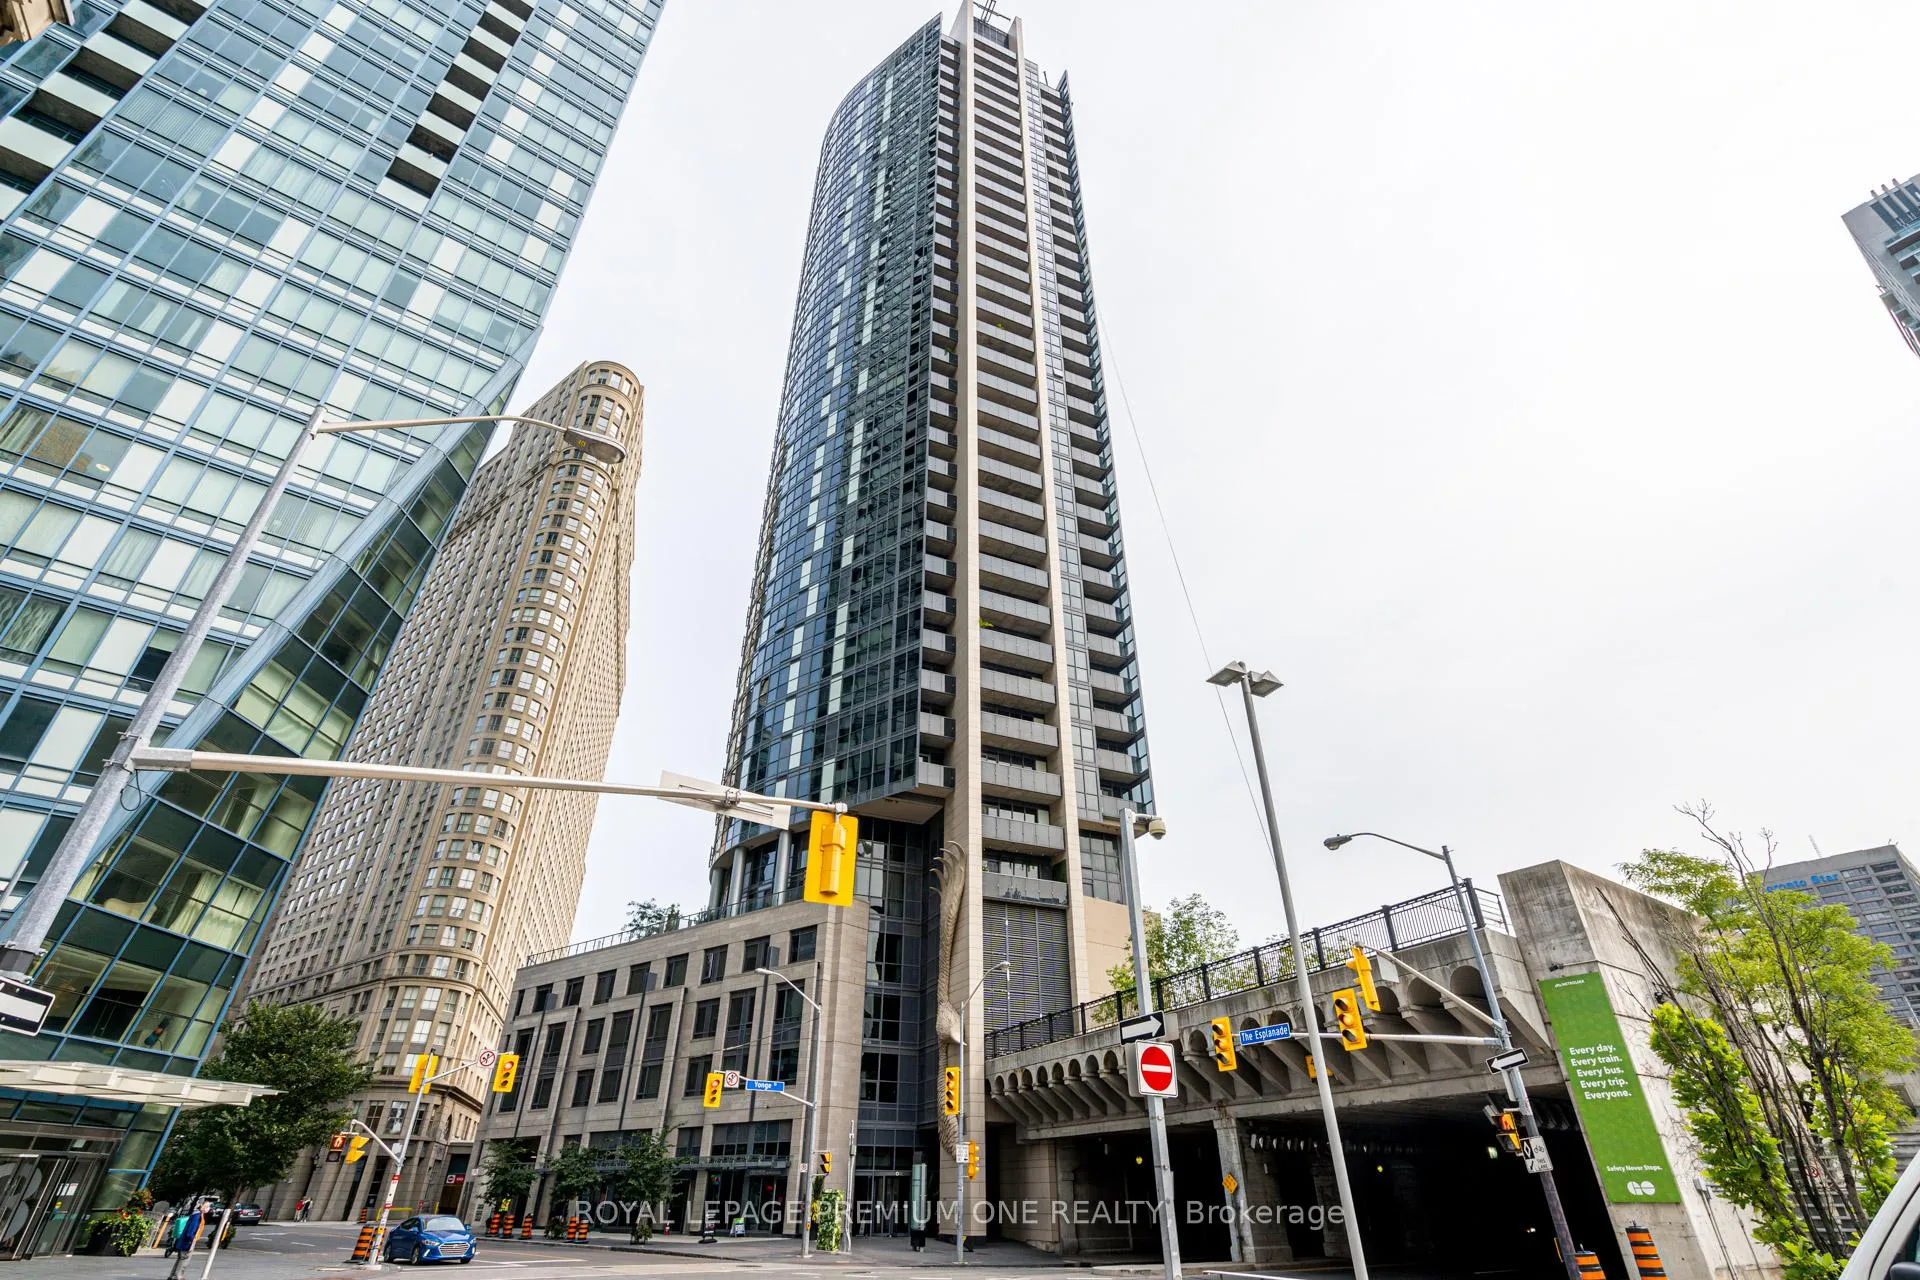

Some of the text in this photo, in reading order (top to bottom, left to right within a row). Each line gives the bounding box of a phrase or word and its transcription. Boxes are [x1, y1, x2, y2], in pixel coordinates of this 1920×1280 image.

[1241, 1026, 1288, 1042] The Esplanade
[1569, 1043, 1616, 1055] Every day.
[1570, 1054, 1623, 1067] Every train.
[1576, 1065, 1625, 1077] Every bus.
[754, 1081, 772, 1091] Yonge
[1580, 1077, 1629, 1089] Every trip.
[1584, 1090, 1632, 1101] Everyone.
[1606, 1164, 1626, 1173] Safety
[1625, 1164, 1643, 1172] Never
